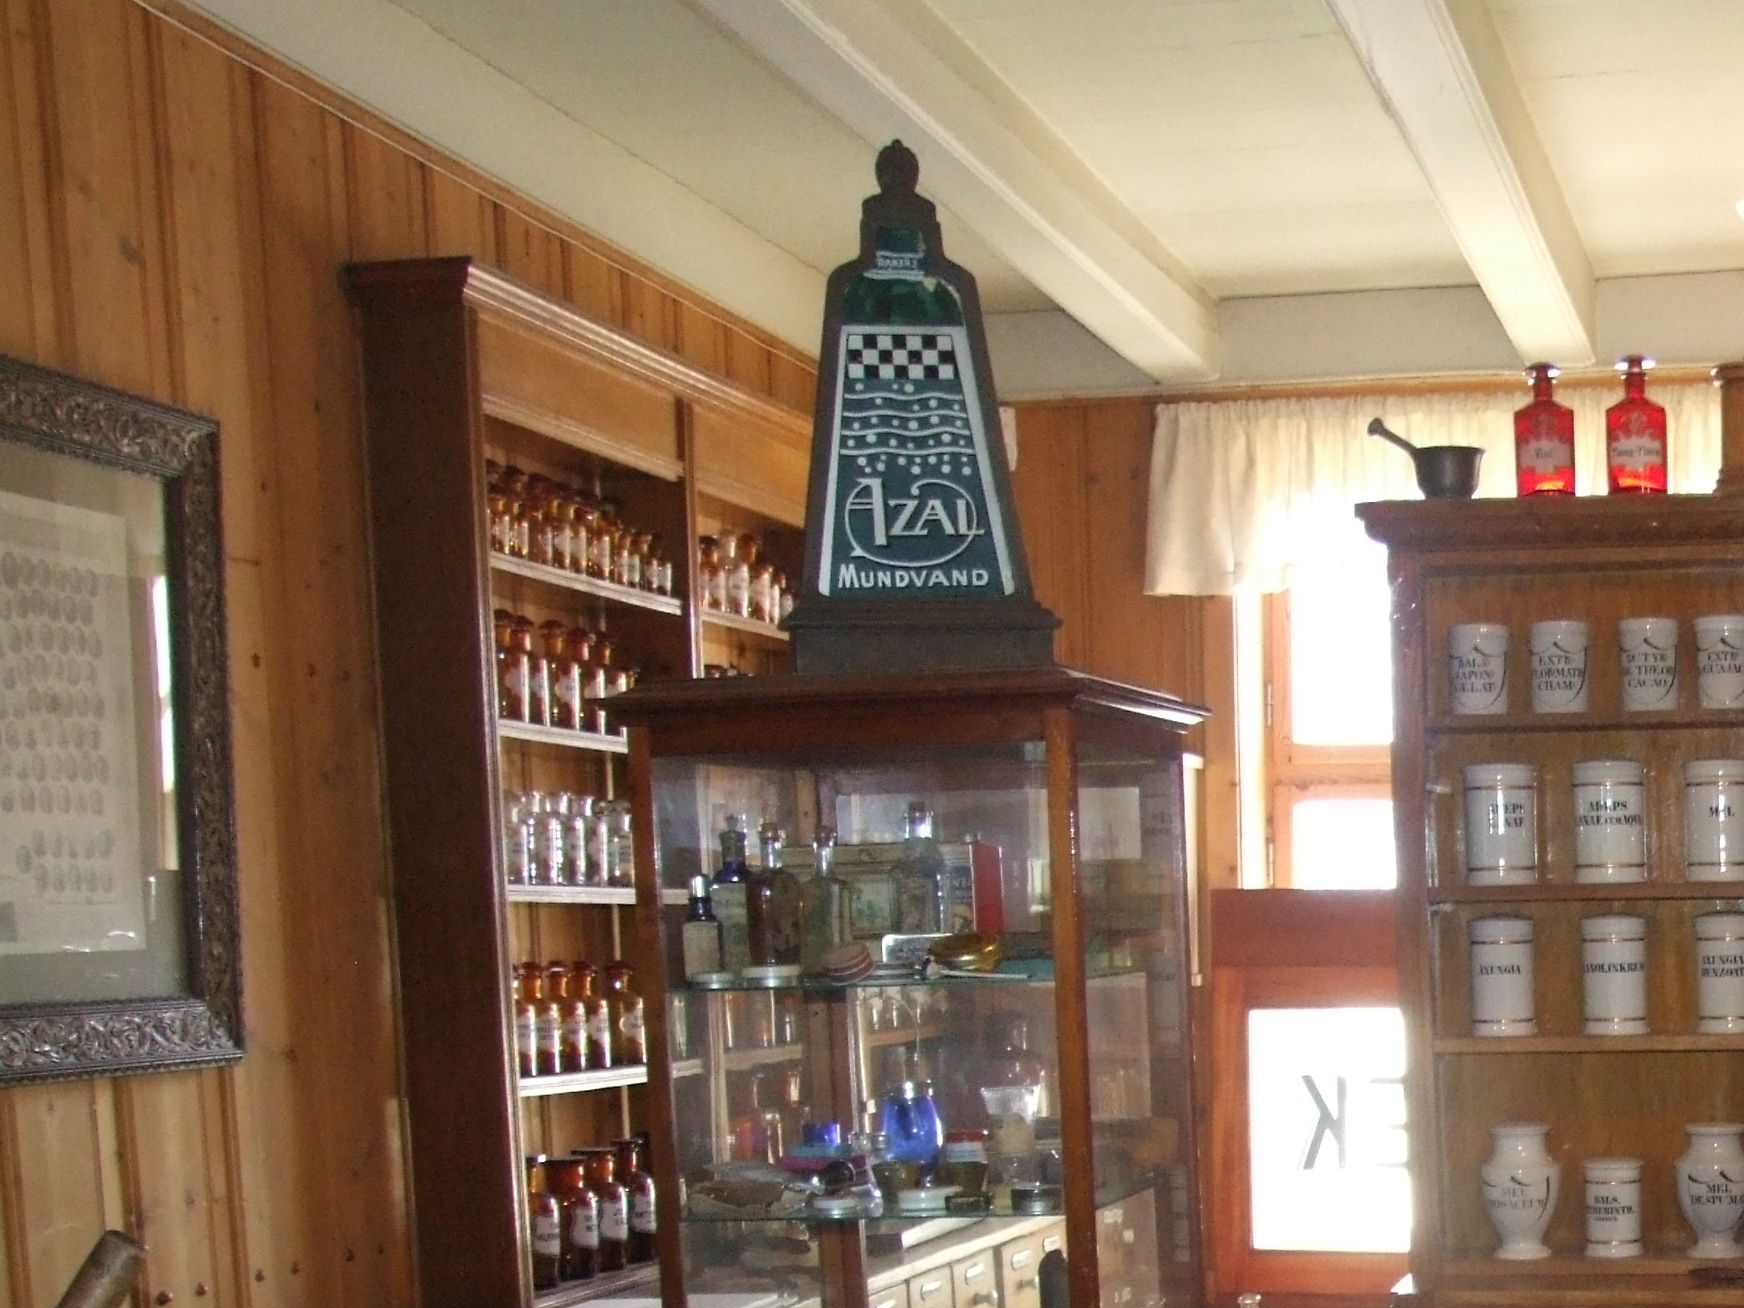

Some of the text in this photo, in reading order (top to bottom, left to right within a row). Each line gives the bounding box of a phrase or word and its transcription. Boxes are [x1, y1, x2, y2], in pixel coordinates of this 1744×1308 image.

[845, 477, 985, 547] AZAL
[838, 563, 989, 589] MUNDVAND
[1708, 806, 1735, 818] ML
